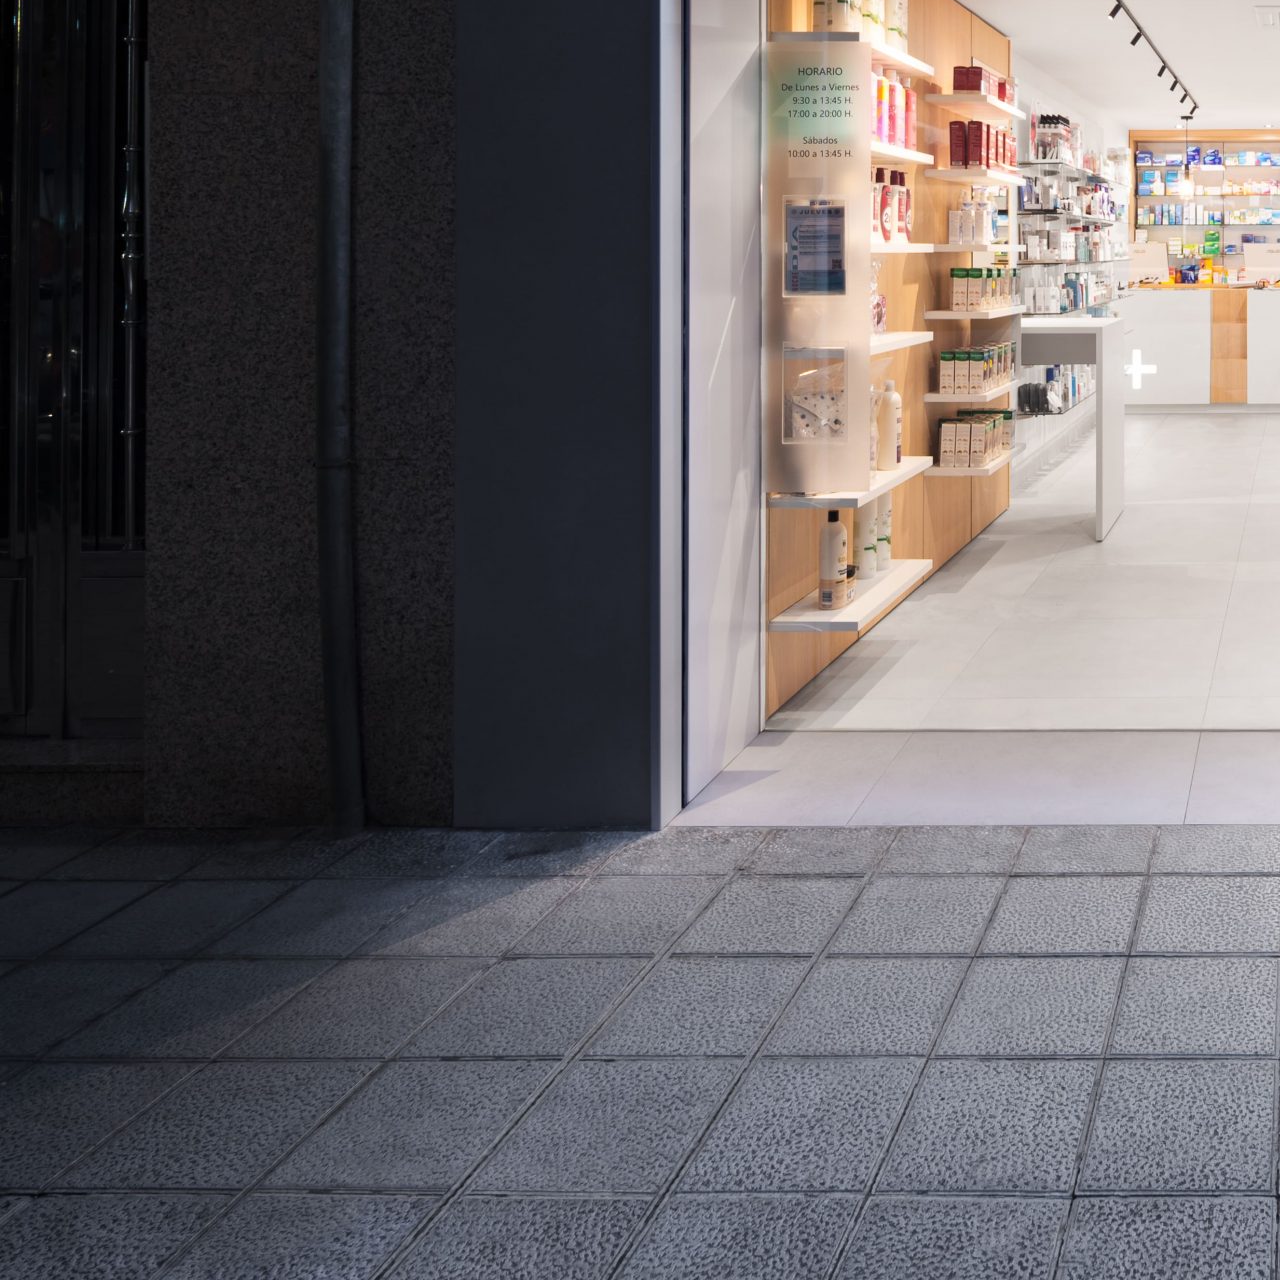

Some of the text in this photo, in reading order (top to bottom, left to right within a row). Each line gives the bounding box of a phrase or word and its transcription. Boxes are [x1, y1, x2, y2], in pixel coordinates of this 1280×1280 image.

[798, 67, 843, 76] HORARIO
[781, 83, 793, 91] De
[795, 83, 819, 91] Lunes
[829, 83, 860, 91] Viernes
[792, 97, 810, 105] 9:30
[820, 97, 842, 105] 13:45
[844, 97, 853, 105] H.
[788, 110, 810, 118] 17:00
[819, 110, 842, 118] 20:00
[844, 110, 853, 118] H.
[802, 136, 838, 144] Sábados
[788, 150, 810, 158] 10:00
[820, 150, 842, 158] 13:45
[844, 150, 853, 158] H.
